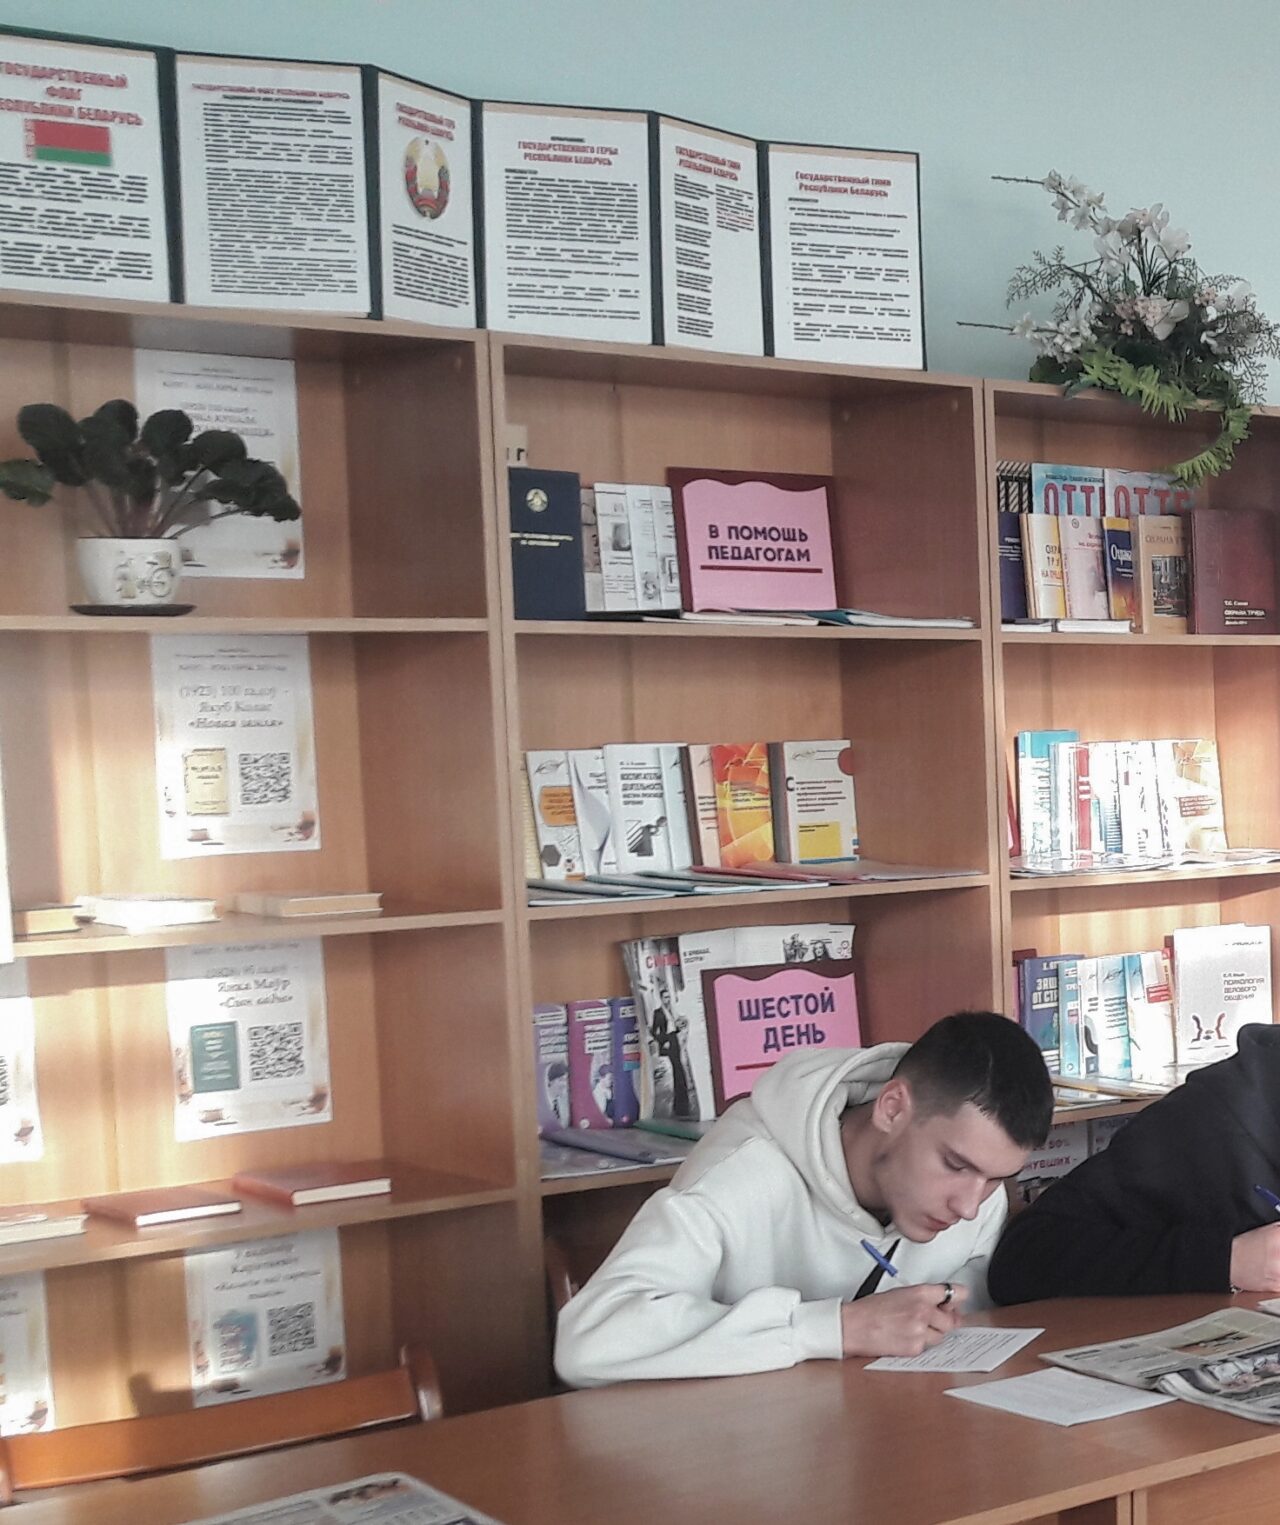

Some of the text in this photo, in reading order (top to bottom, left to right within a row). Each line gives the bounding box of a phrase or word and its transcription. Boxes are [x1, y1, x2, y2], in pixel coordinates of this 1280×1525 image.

[0, 98, 143, 126] ЕСПУБЛИКИ БЕЛАРУСЬ
[795, 170, 892, 187] Государственный гимн
[799, 182, 889, 198] Республики Беларусь
[708, 524, 809, 543] В ПОМОЩЬ
[708, 545, 811, 563] ПЕДАГОГАМ
[738, 986, 837, 1022] ШЕСТОЙ
[763, 1023, 826, 1053] ДЕНЬ
